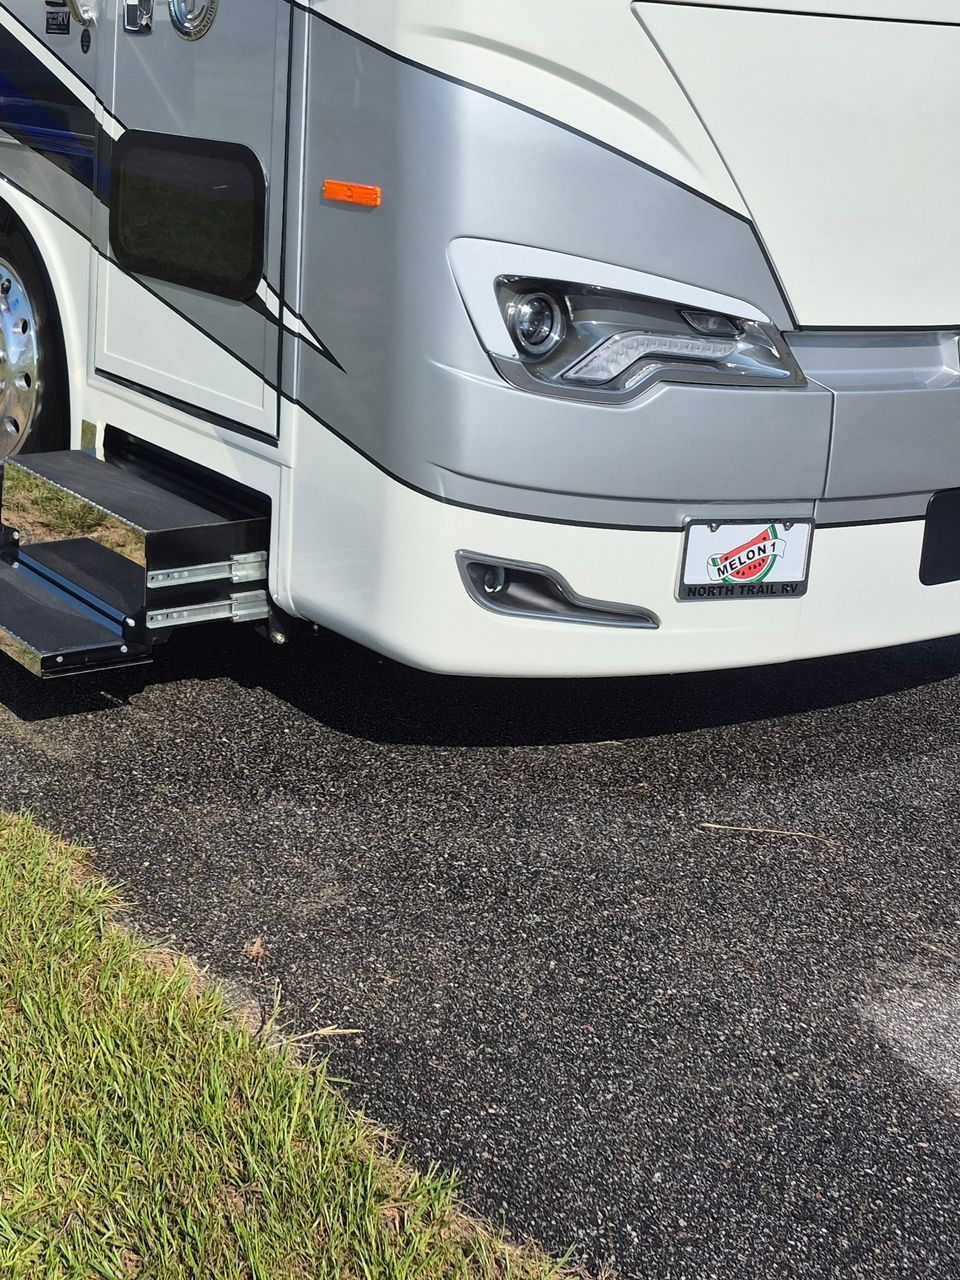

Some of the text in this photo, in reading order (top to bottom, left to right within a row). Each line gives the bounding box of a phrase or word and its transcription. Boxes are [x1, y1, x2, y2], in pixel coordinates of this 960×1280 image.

[717, 542, 777, 578] MELON 1
[687, 583, 799, 597] NORTH TRAIL RV
